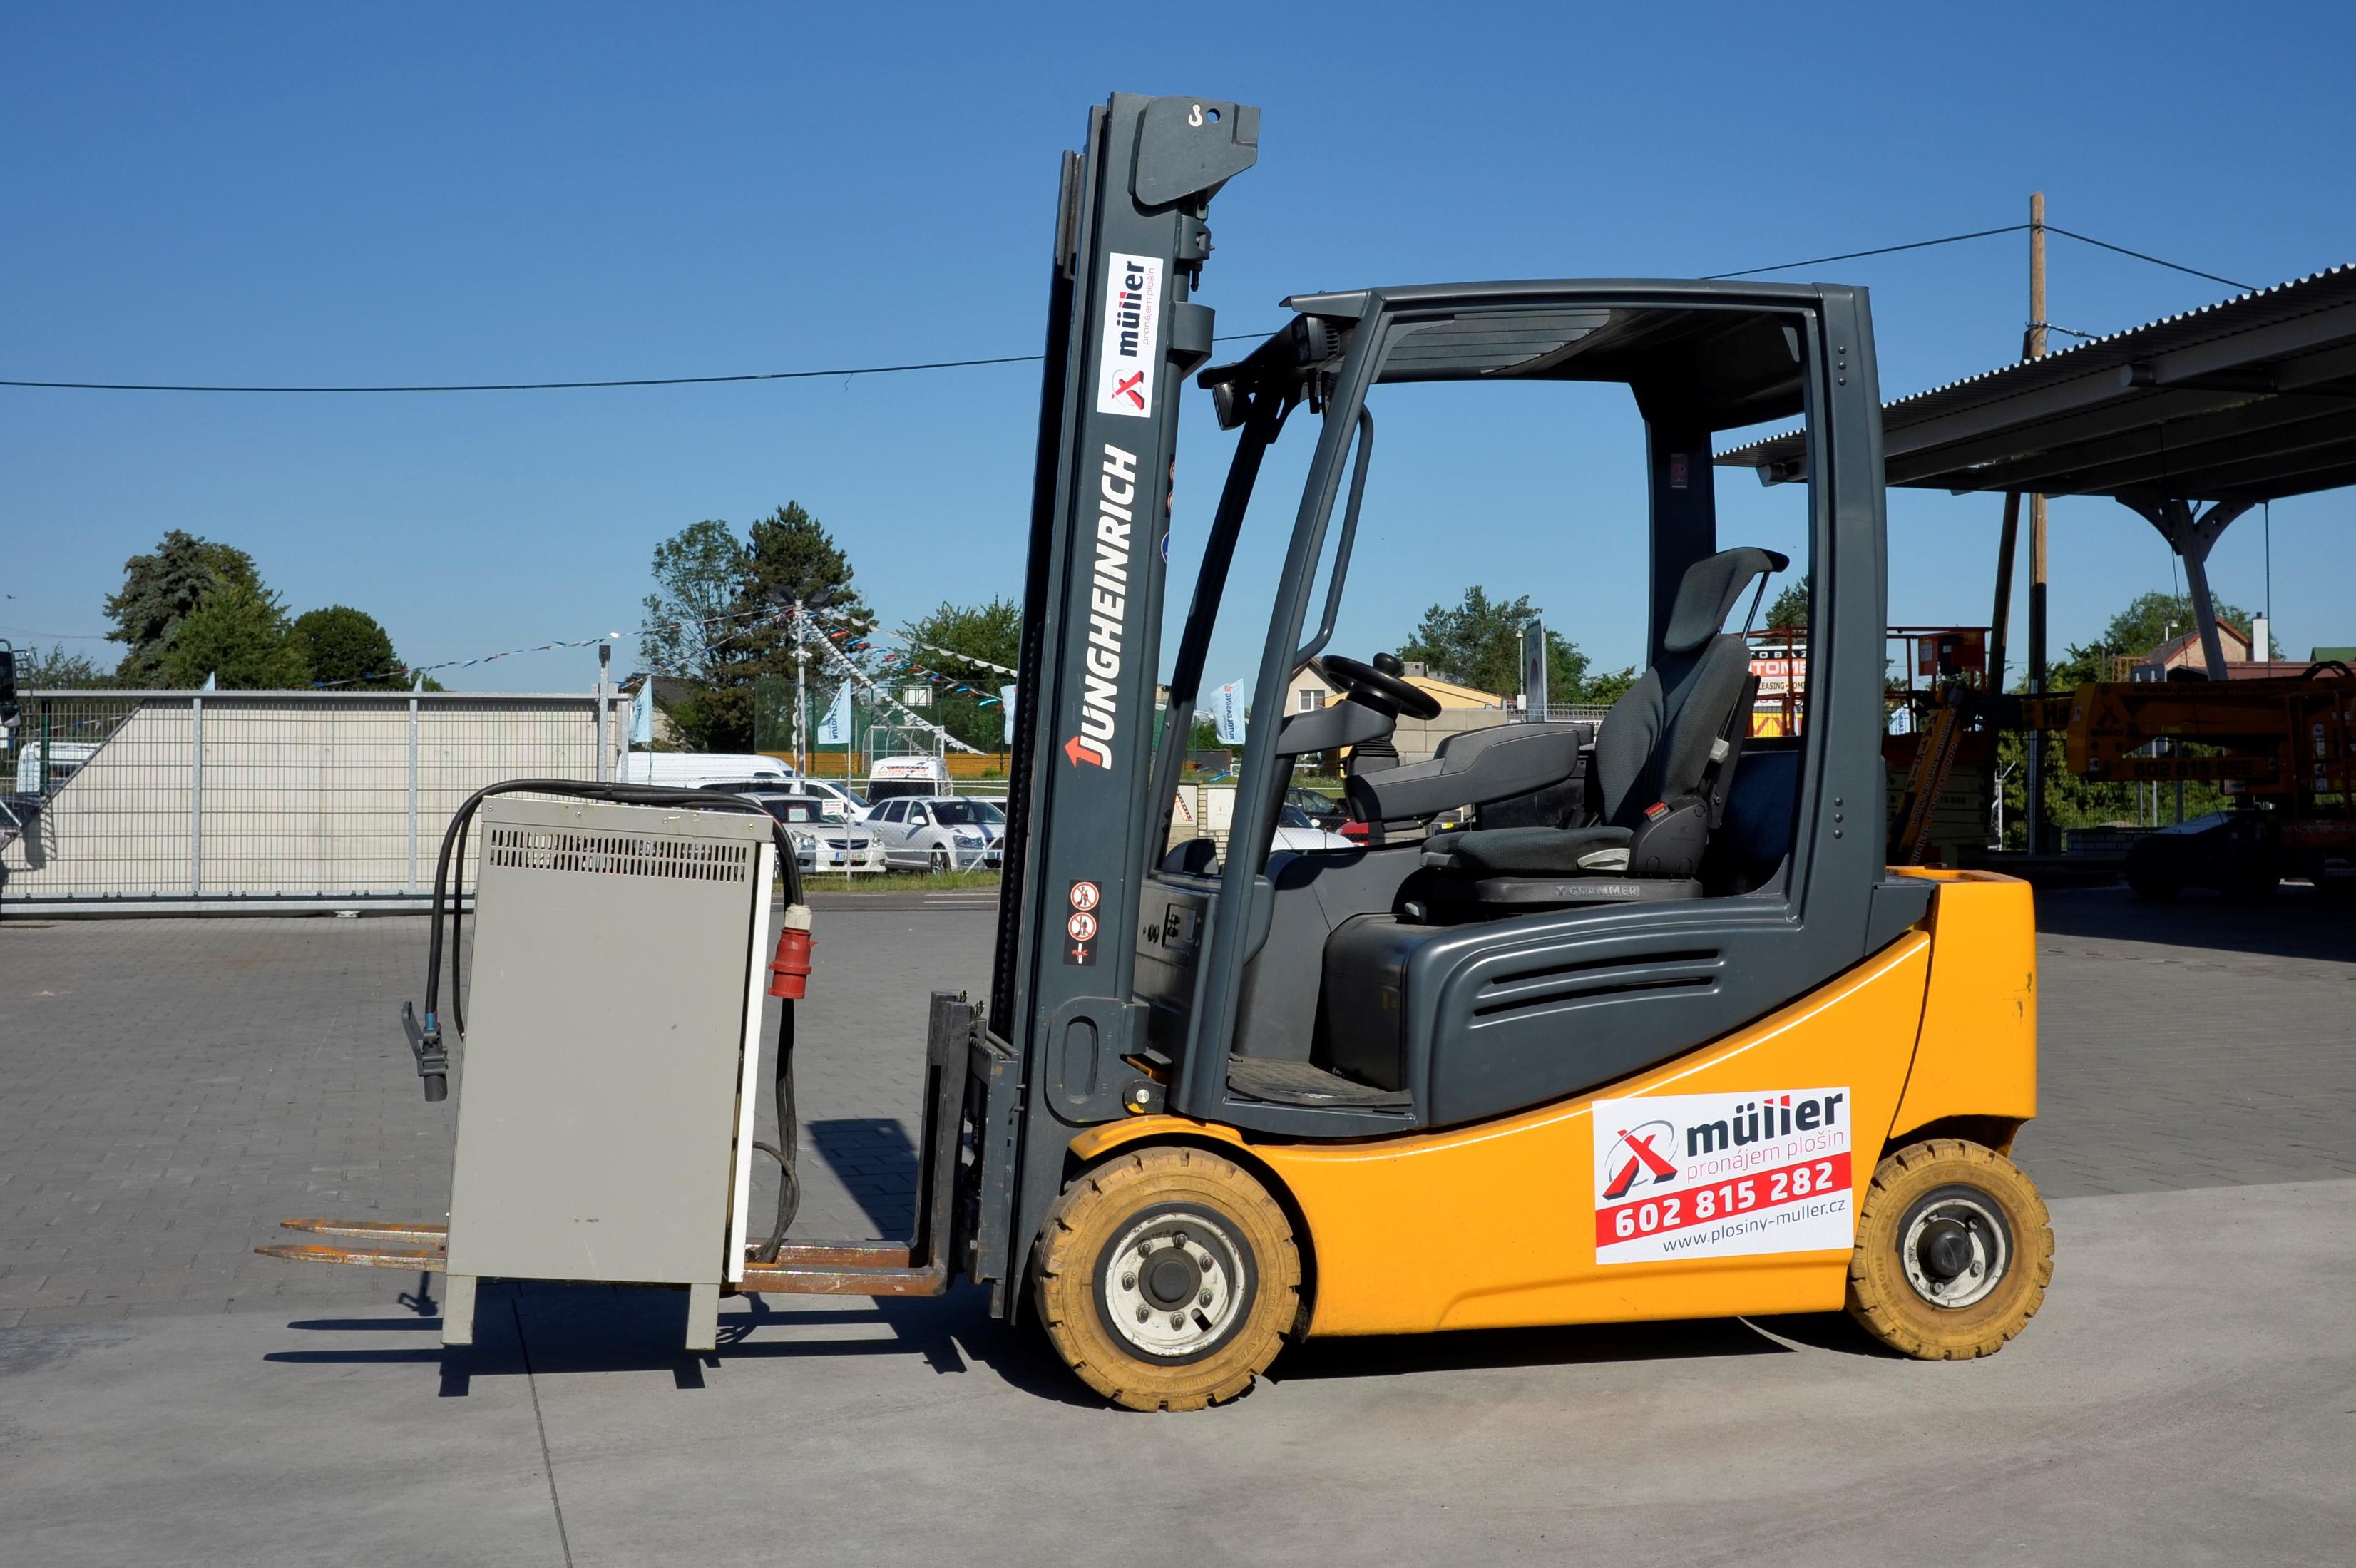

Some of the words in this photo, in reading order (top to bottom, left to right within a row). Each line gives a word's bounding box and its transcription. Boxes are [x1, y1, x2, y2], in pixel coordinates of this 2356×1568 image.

[1117, 260, 1144, 357] müller
[1143, 297, 1153, 345] pronájem
[1077, 443, 1137, 770] JUNGHEINRICH
[2134, 762, 2170, 777] 602
[2177, 762, 2210, 777] 815
[2218, 761, 2253, 777] 282
[1569, 885, 1640, 897] GRAMMER
[1686, 1093, 1843, 1157] müller
[1687, 1146, 1781, 1183] pronájem
[1786, 1129, 1844, 1160] plošin
[1614, 1198, 1681, 1238] 602
[1695, 1180, 1756, 1219] 815
[1770, 1162, 1834, 1202] 282
[1662, 1199, 1846, 1253] www.plosiny-muller.cz
